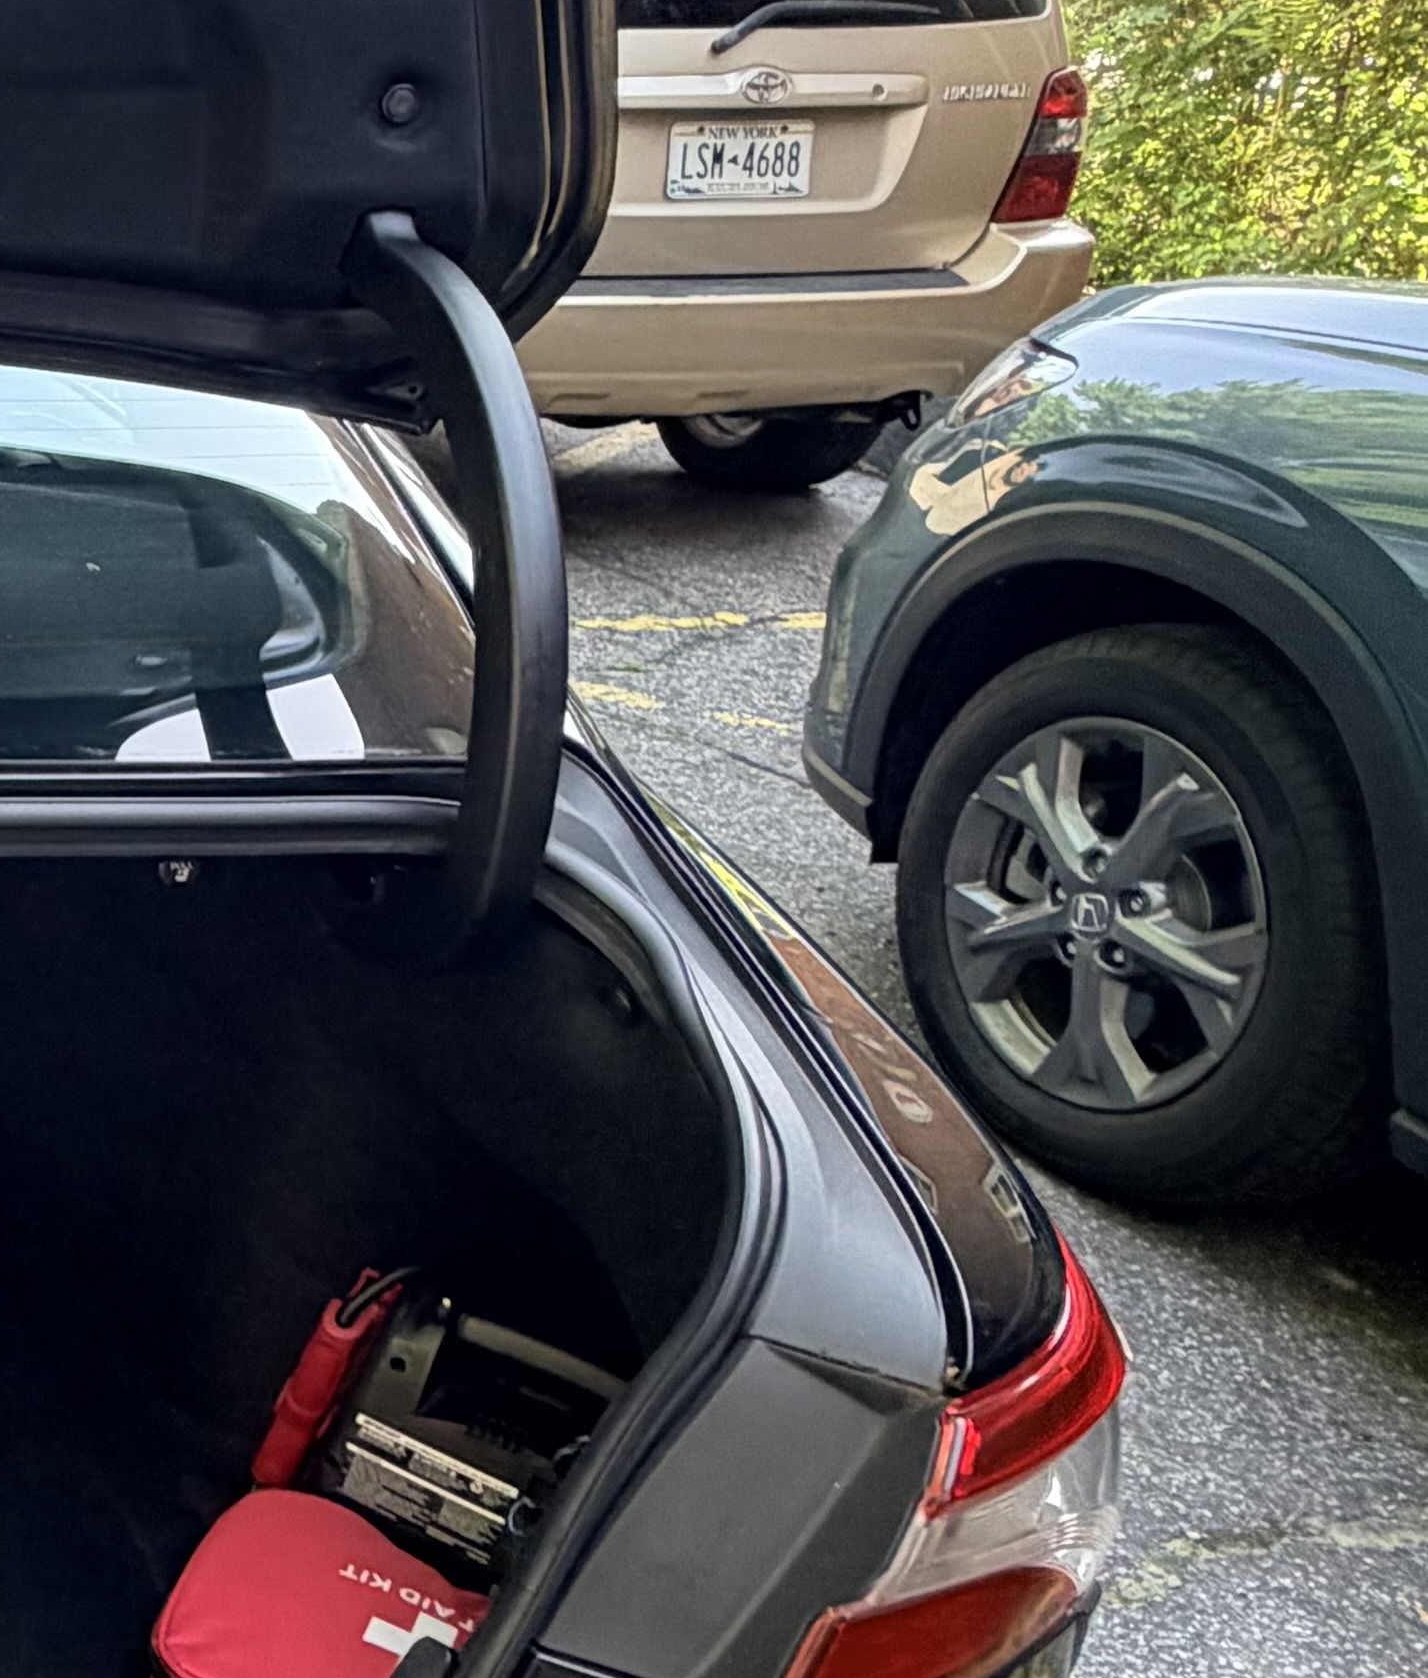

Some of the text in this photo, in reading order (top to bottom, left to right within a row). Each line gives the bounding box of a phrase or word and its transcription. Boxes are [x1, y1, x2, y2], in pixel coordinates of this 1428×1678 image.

[708, 124, 779, 140] NEW YORK
[741, 140, 802, 179] 4688
[338, 1563, 456, 1618] AID KIT
